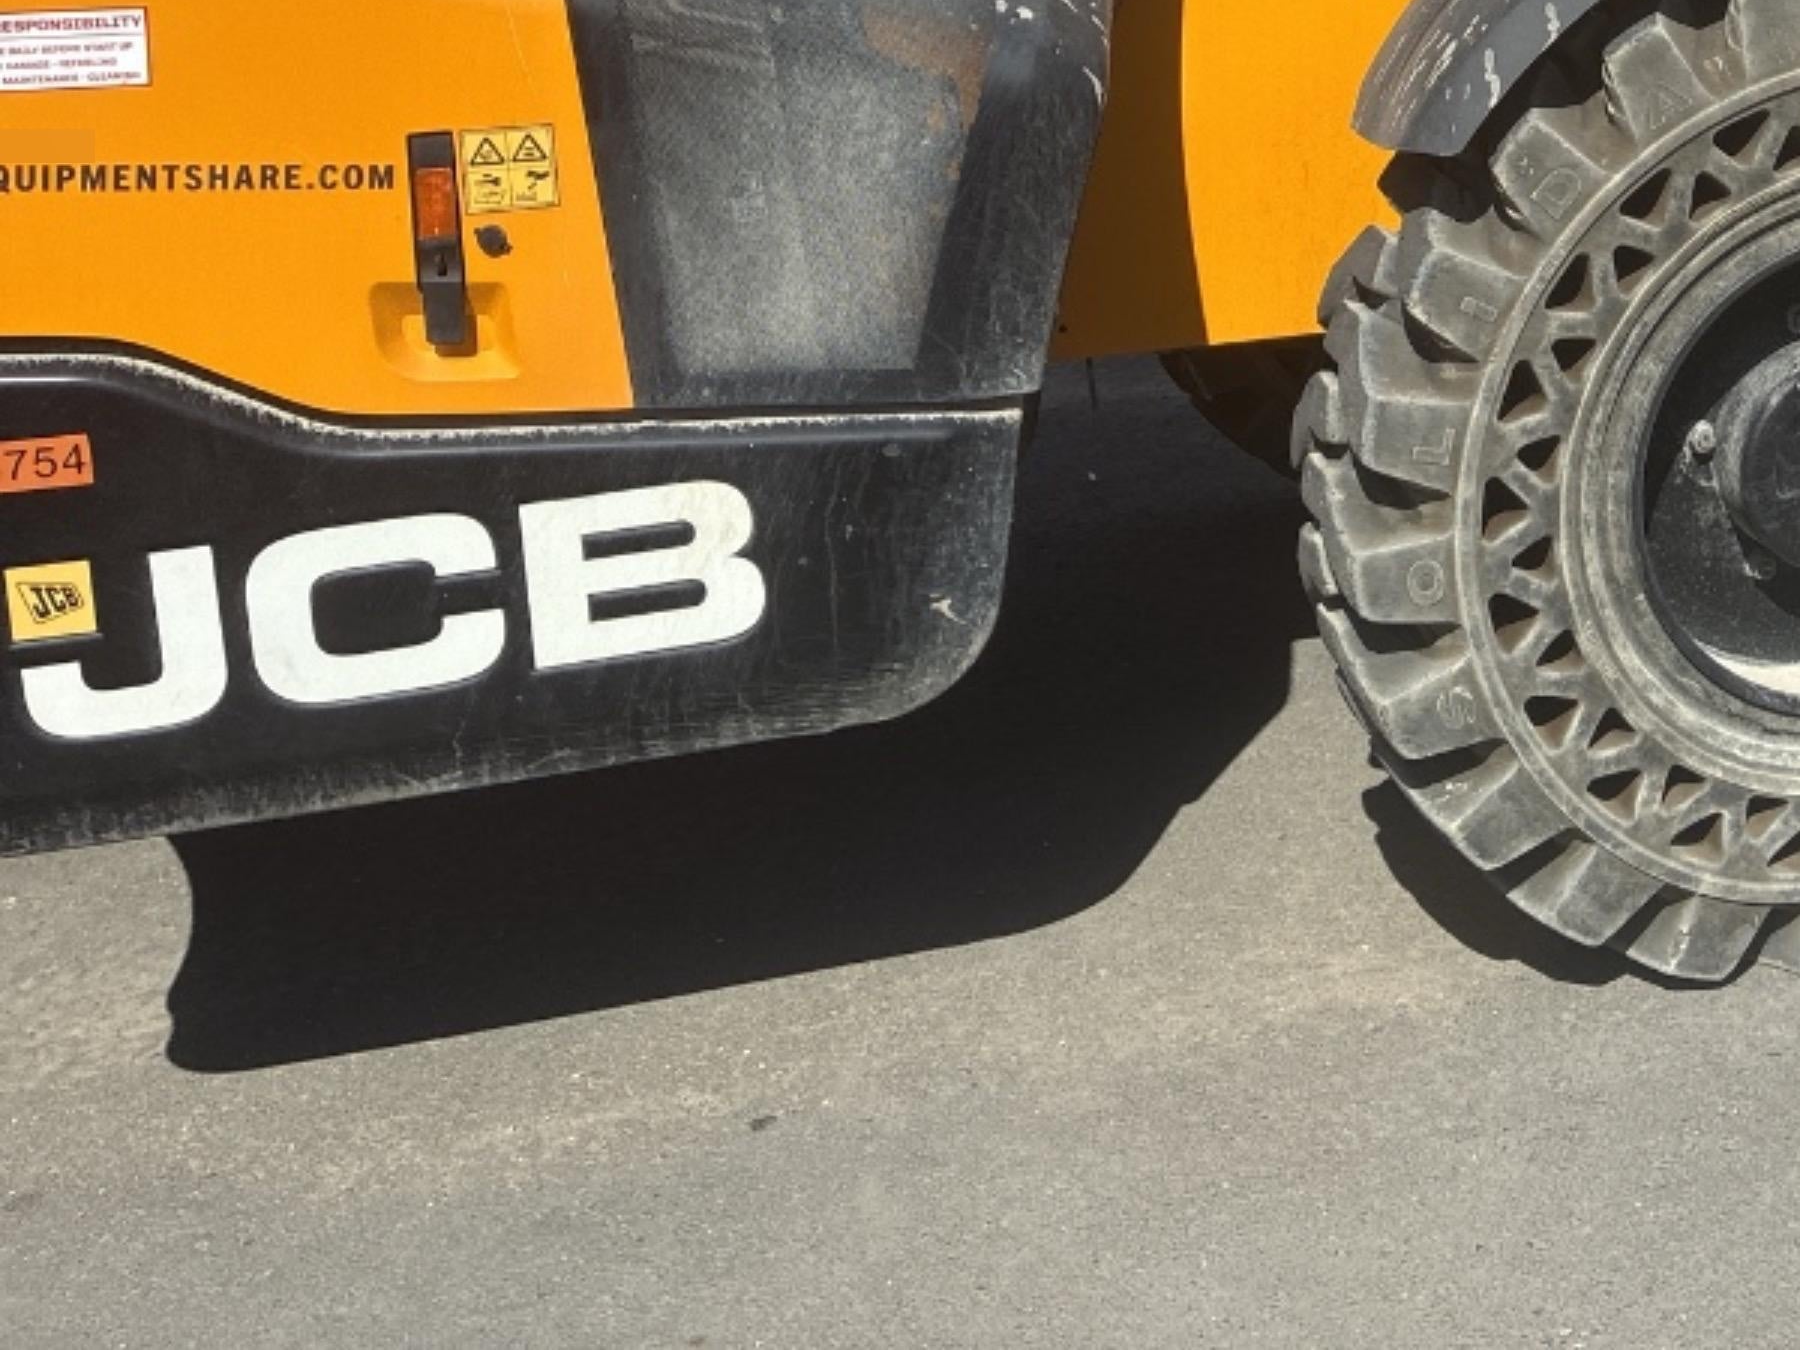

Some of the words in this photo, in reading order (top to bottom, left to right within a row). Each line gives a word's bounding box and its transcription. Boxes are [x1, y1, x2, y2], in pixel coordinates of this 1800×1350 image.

[0, 15, 141, 33] ESPONSIBILITY
[3, 443, 87, 481] 754
[20, 480, 767, 741] JCB
[29, 585, 80, 619] JCB
